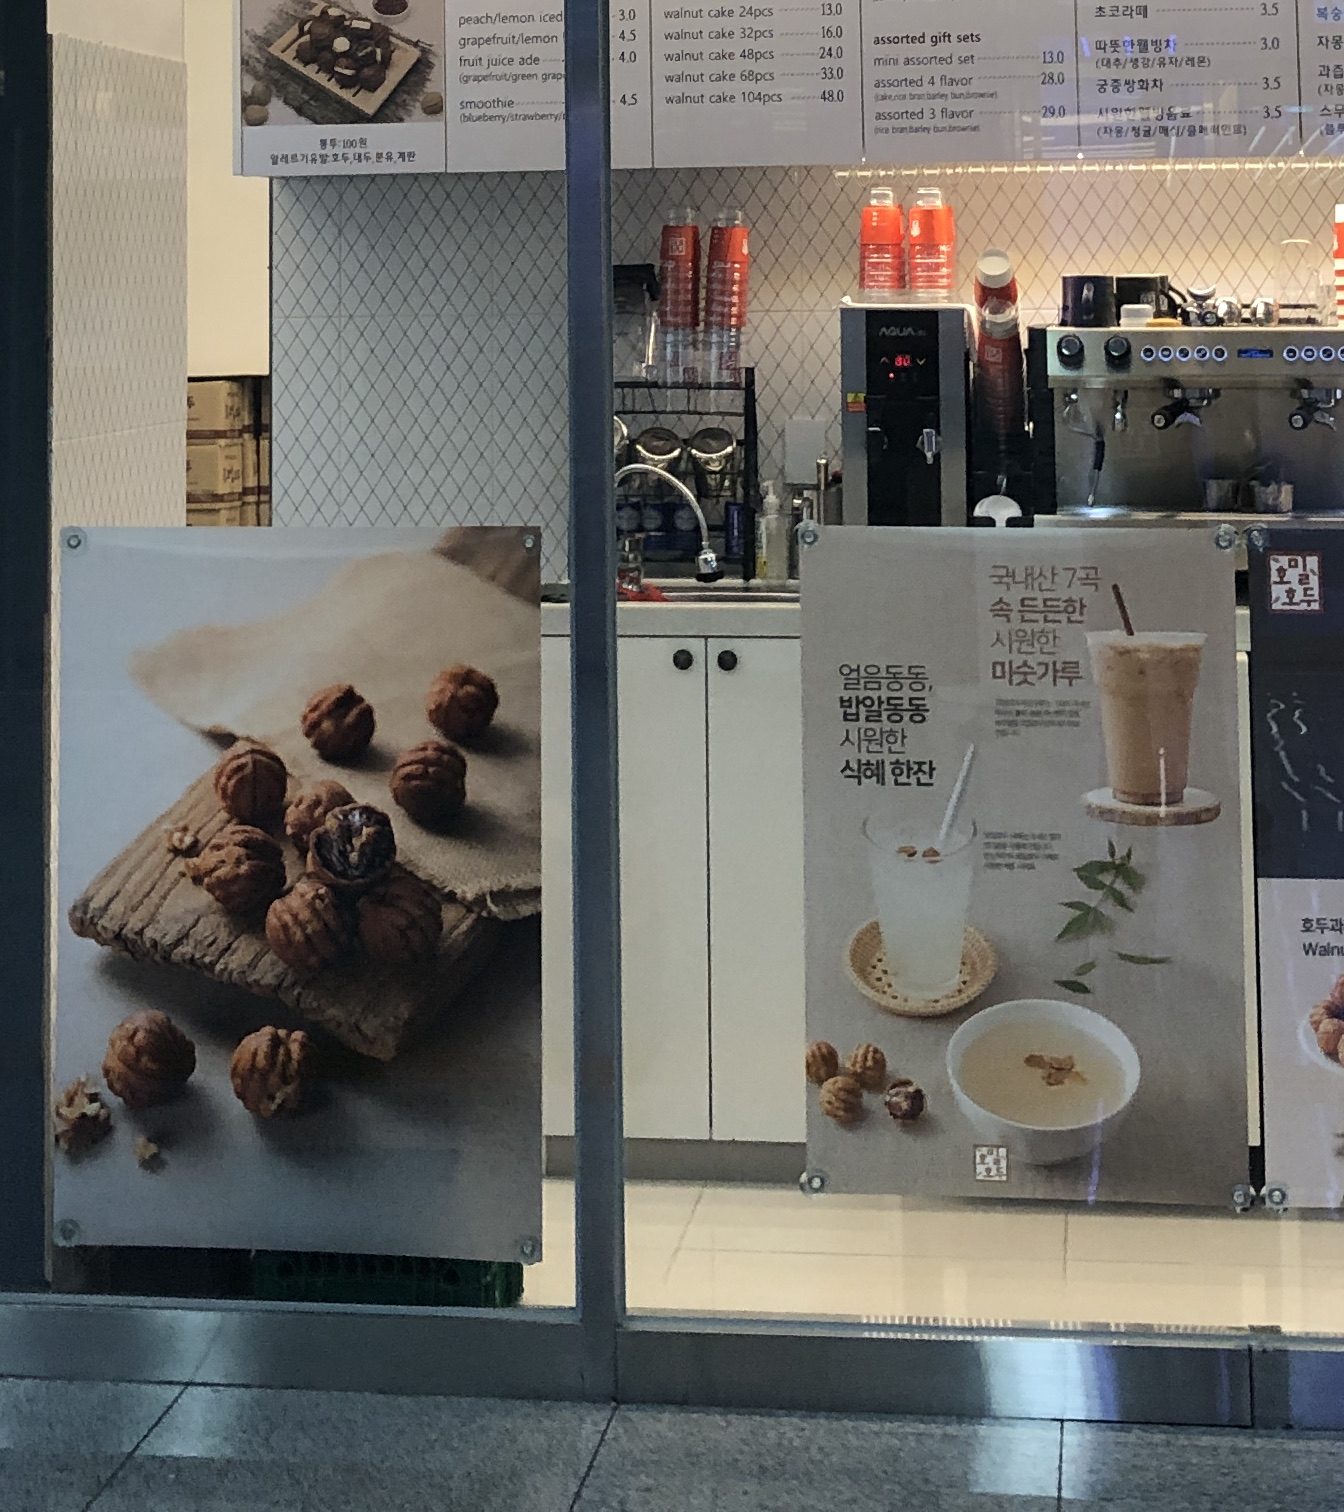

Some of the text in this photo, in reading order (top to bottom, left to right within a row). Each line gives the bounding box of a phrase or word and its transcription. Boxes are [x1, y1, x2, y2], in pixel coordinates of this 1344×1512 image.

[458, 9, 636, 27] peach/lemon iced 3.0
[1094, 4, 1279, 18] 초코라떼 3.5
[458, 30, 636, 49] grapefruit/lemon 4.5
[873, 32, 981, 46] assorted gift sets
[1261, 38, 1279, 50] 3.0
[459, 51, 636, 69] fruit juice ade 4.0
[873, 51, 1064, 66] mini assorted set 13.0
[874, 73, 1064, 88] assorted 4 flavor 28.0
[1262, 77, 1281, 89] 3.5
[459, 94, 637, 110] smoothie 4.5
[665, 90, 844, 105] walnut cake 104pcs 48.0
[989, 565, 1101, 592] 국내산 7곡
[1272, 557, 1310, 585] 호밀
[1281, 587, 1319, 607] 호두
[989, 597, 1087, 624] 속 든든한
[991, 628, 1061, 655] 시원한
[839, 664, 933, 692] 얼음동동,
[991, 660, 1083, 687] 미숫가루
[839, 695, 930, 724] 밥알동동
[839, 727, 908, 755] 시원한
[840, 758, 936, 787] 식혜 한잔
